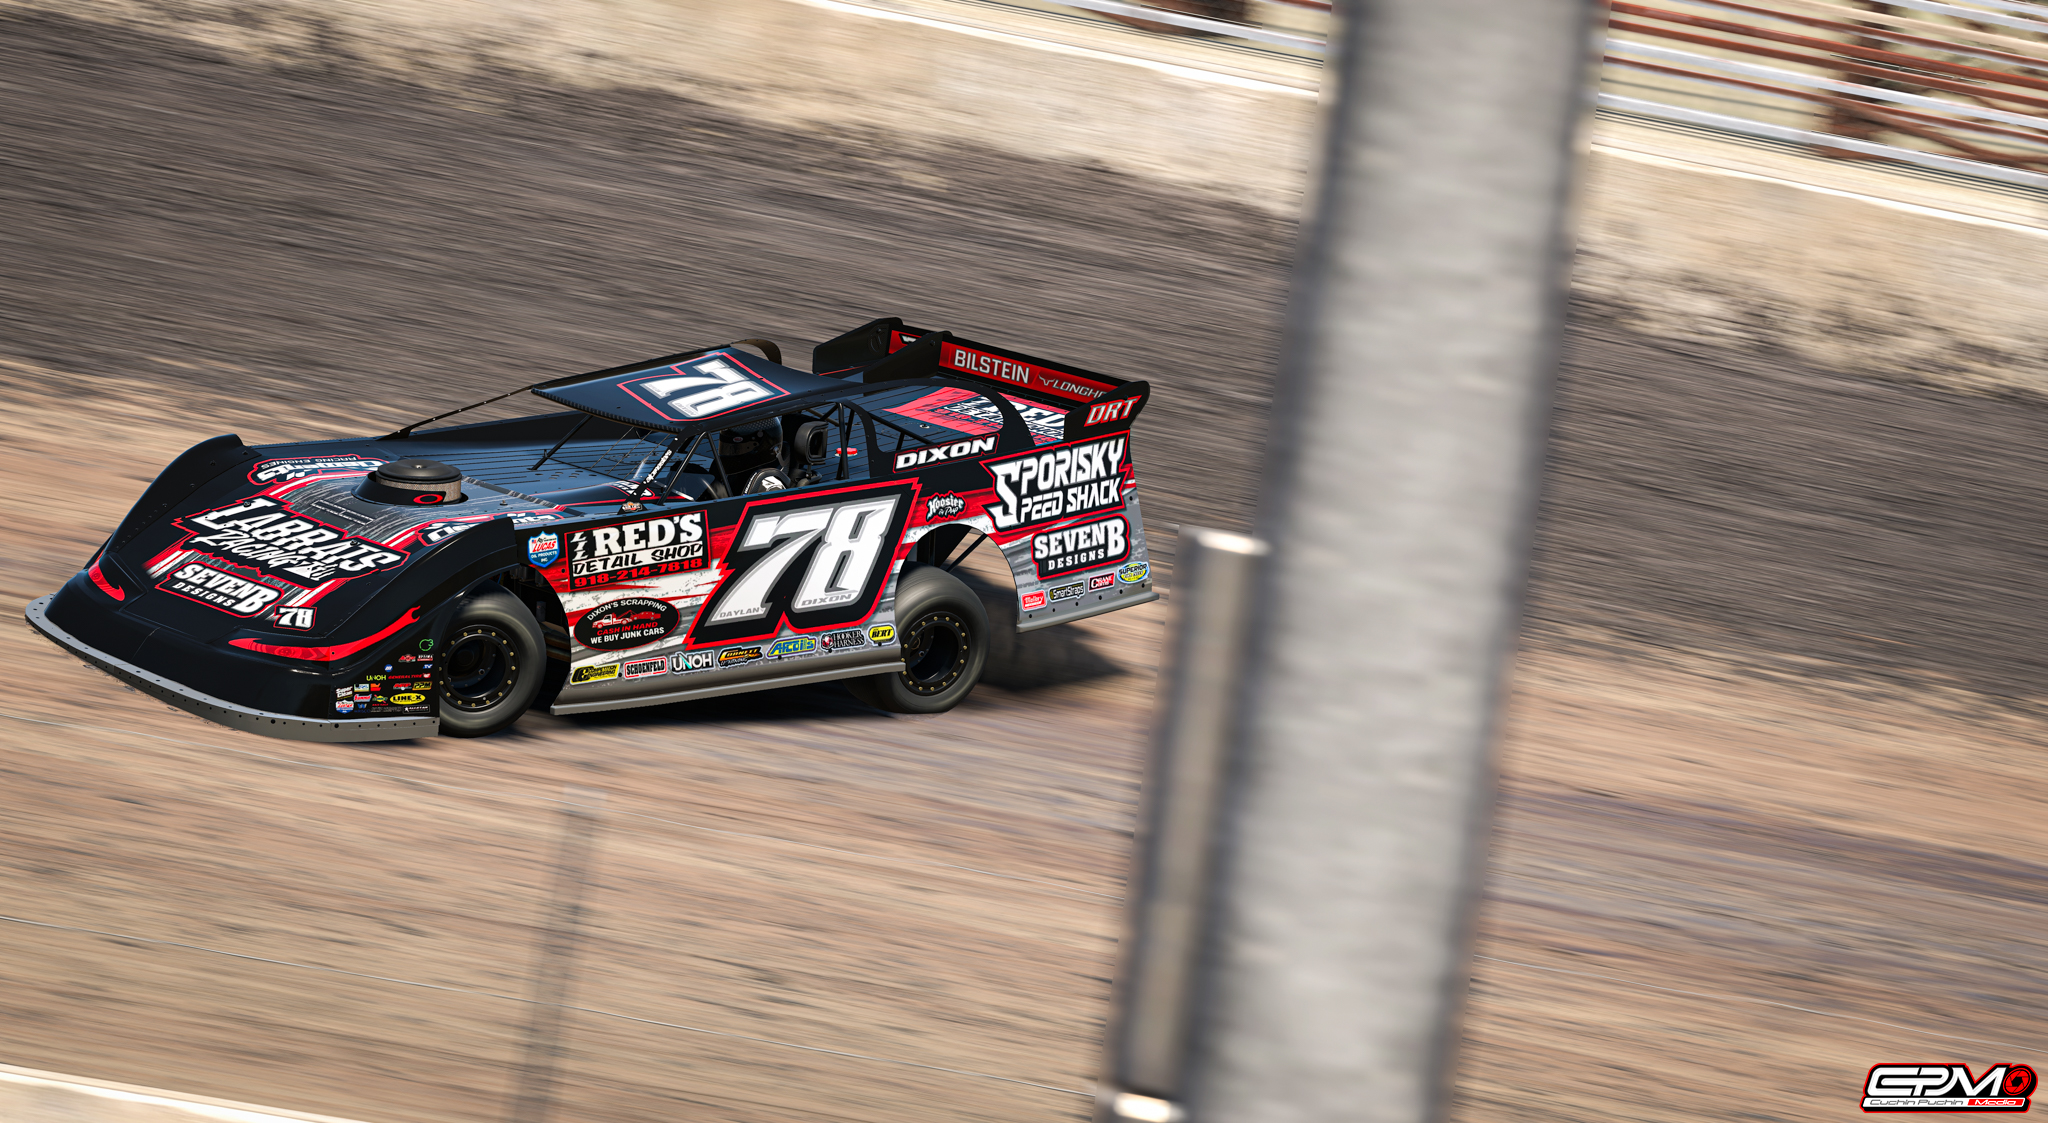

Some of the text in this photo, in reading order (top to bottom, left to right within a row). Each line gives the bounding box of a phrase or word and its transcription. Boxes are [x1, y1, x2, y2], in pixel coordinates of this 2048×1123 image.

[954, 349, 1030, 385] BILSTEIN
[639, 359, 774, 417] 78
[1086, 397, 1139, 425] DRT
[895, 436, 996, 470] DIXON
[988, 437, 1125, 516] SPORISKY
[1065, 476, 1121, 514] SHACK
[593, 512, 703, 557] RED'S
[532, 540, 557, 553] LUCAS
[573, 543, 703, 575] DETAIL SHOP
[708, 497, 899, 624] 78
[1048, 549, 1105, 571] DESIGNS
[1118, 563, 1148, 575] SUPERIOR
[574, 558, 703, 588] 918-214-7818
[172, 581, 236, 607] DESIGNS
[801, 593, 852, 607] DIXON
[1053, 584, 1084, 600] SmartStraps
[278, 607, 314, 629] 78
[586, 599, 667, 621] DIXON'S SCRAPPING
[719, 606, 760, 619] DAYLAN
[590, 626, 665, 645] WE BUY JUNK CARS
[597, 621, 658, 636] CASH IN HAND
[833, 630, 862, 640] HOOKER
[872, 628, 893, 638] BERT
[834, 638, 864, 648] HARNESS
[626, 659, 666, 676] SCHOENFELD
[672, 652, 713, 671] UNOH
